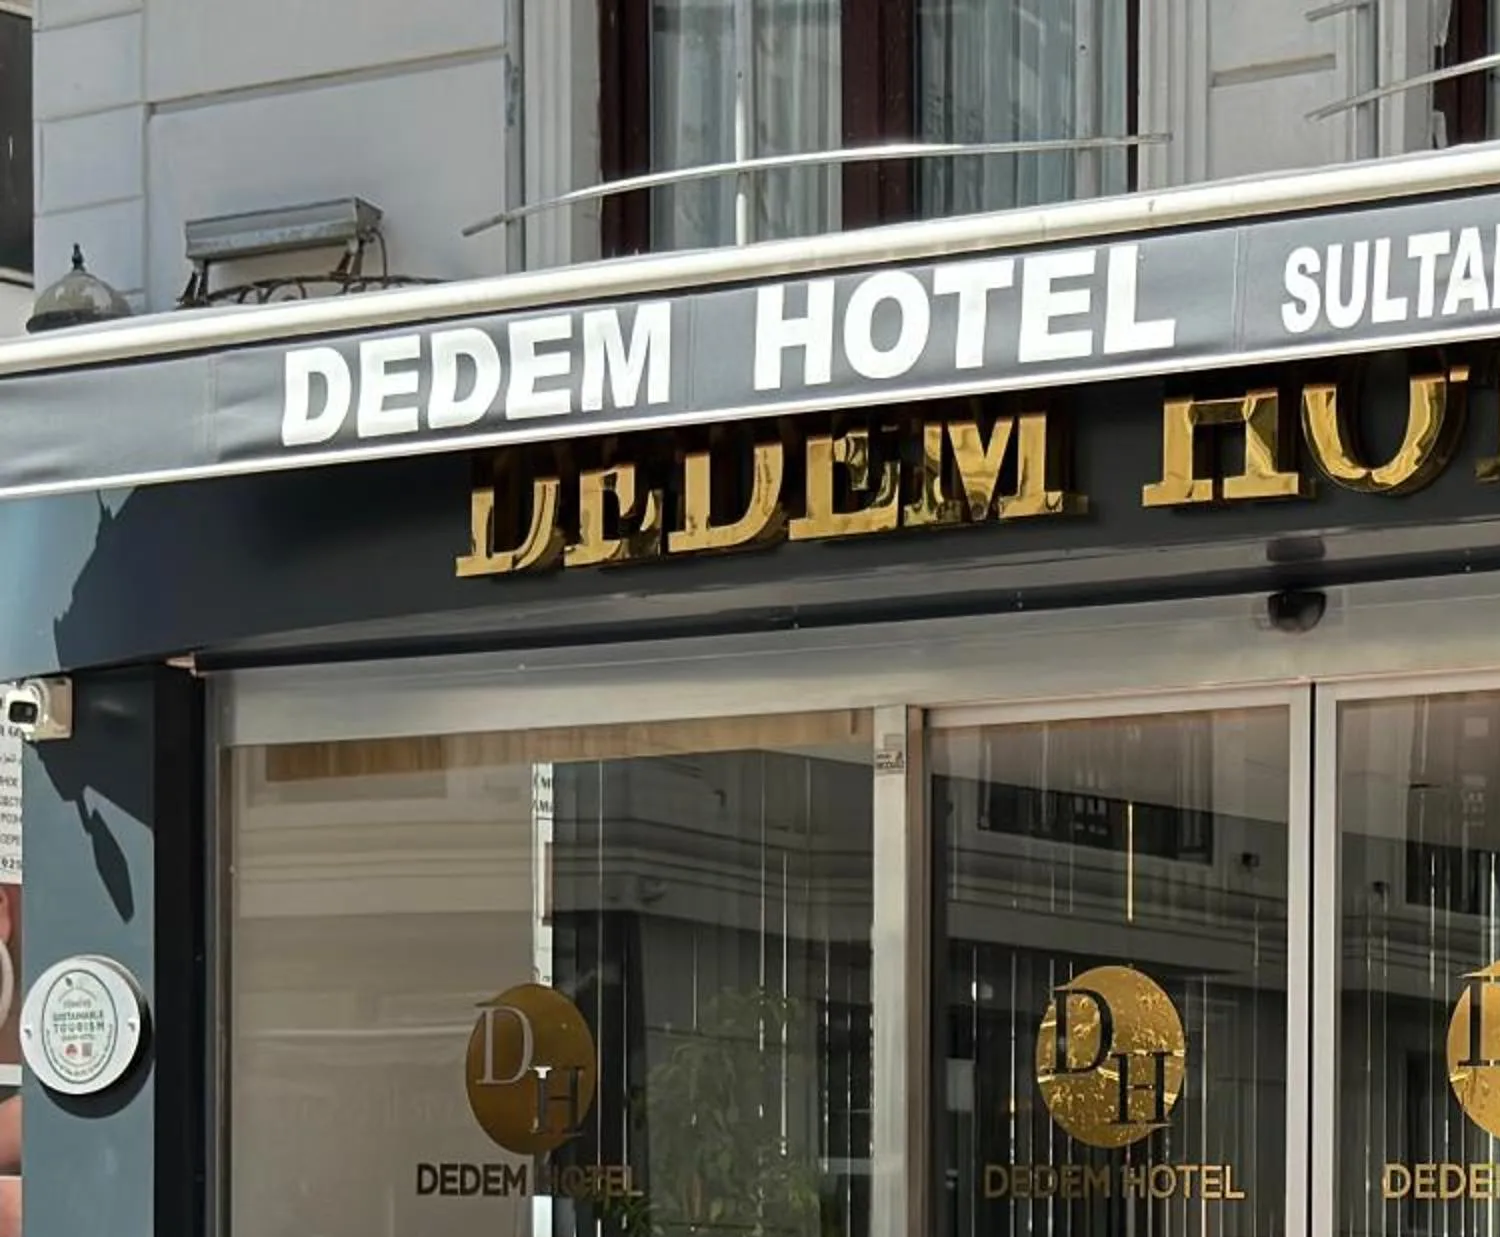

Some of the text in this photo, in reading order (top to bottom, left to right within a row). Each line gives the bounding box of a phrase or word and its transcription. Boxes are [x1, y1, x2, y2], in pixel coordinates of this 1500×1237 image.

[281, 244, 1178, 447] DEDEM HOTEL
[416, 1163, 528, 1197] DEDEM
[983, 1164, 1246, 1199] DEDEM HOTEL
